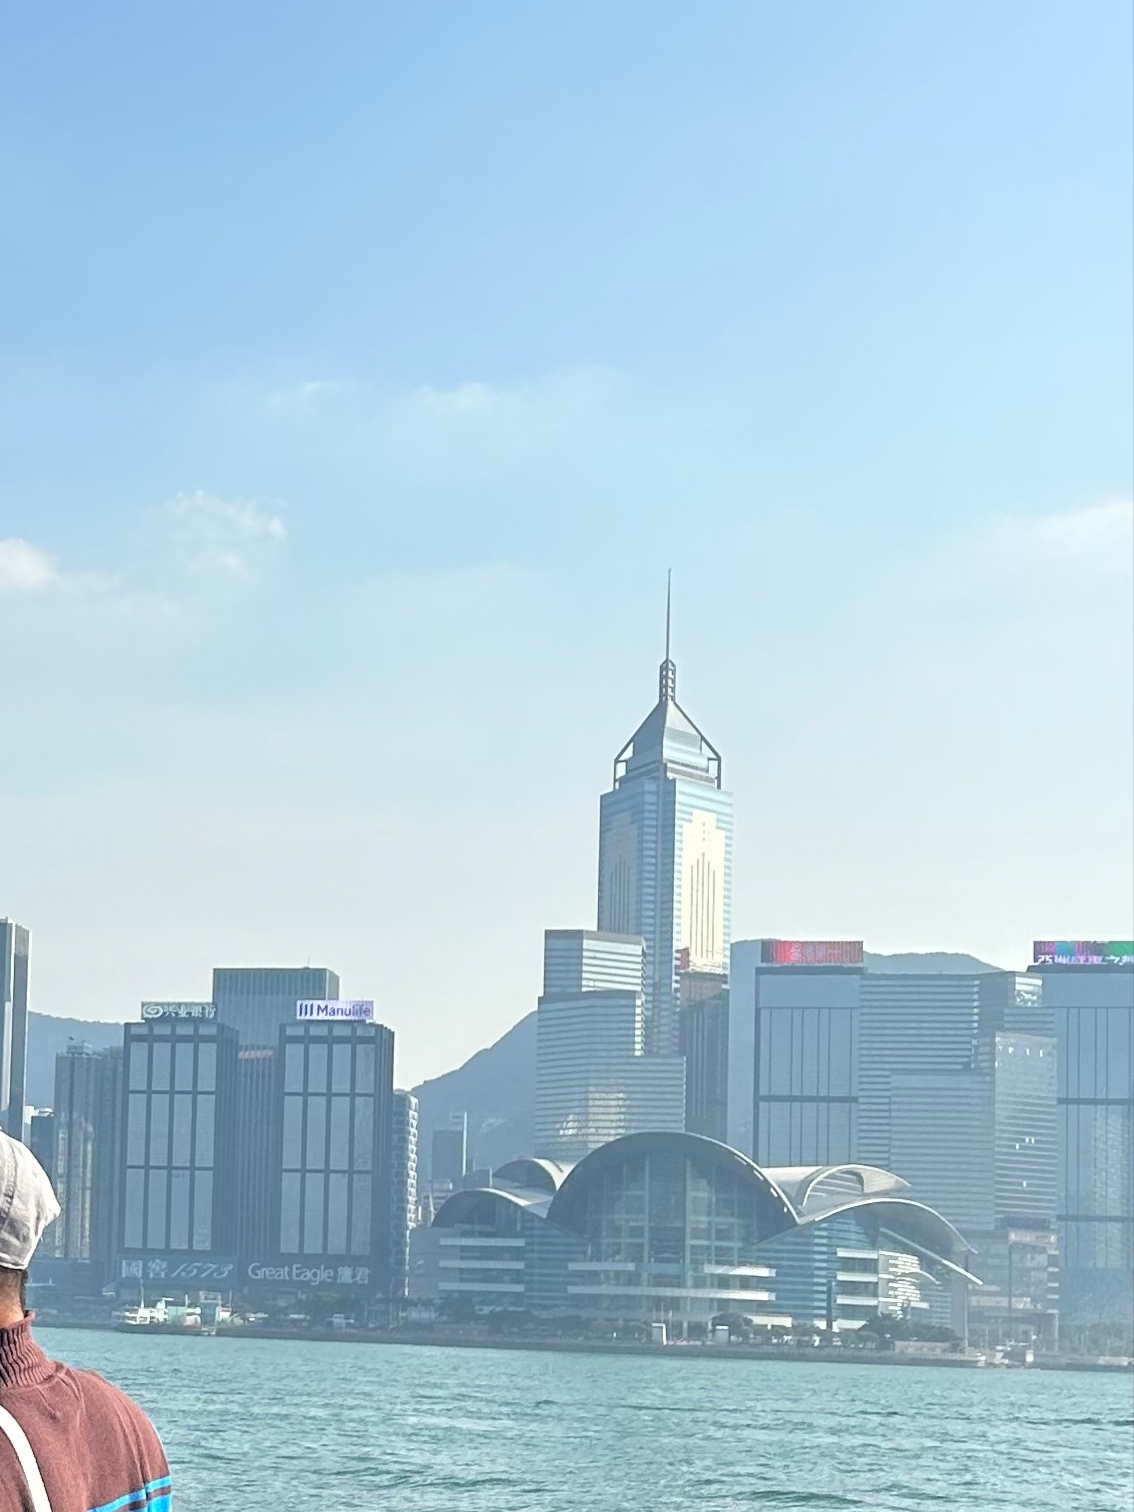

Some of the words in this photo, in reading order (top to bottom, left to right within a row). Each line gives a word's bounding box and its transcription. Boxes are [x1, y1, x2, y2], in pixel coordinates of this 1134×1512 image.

[317, 1003, 371, 1018] Manulife
[171, 1262, 234, 1279] 1573
[248, 1262, 290, 1280] Great
[292, 1263, 334, 1286] Eagle
